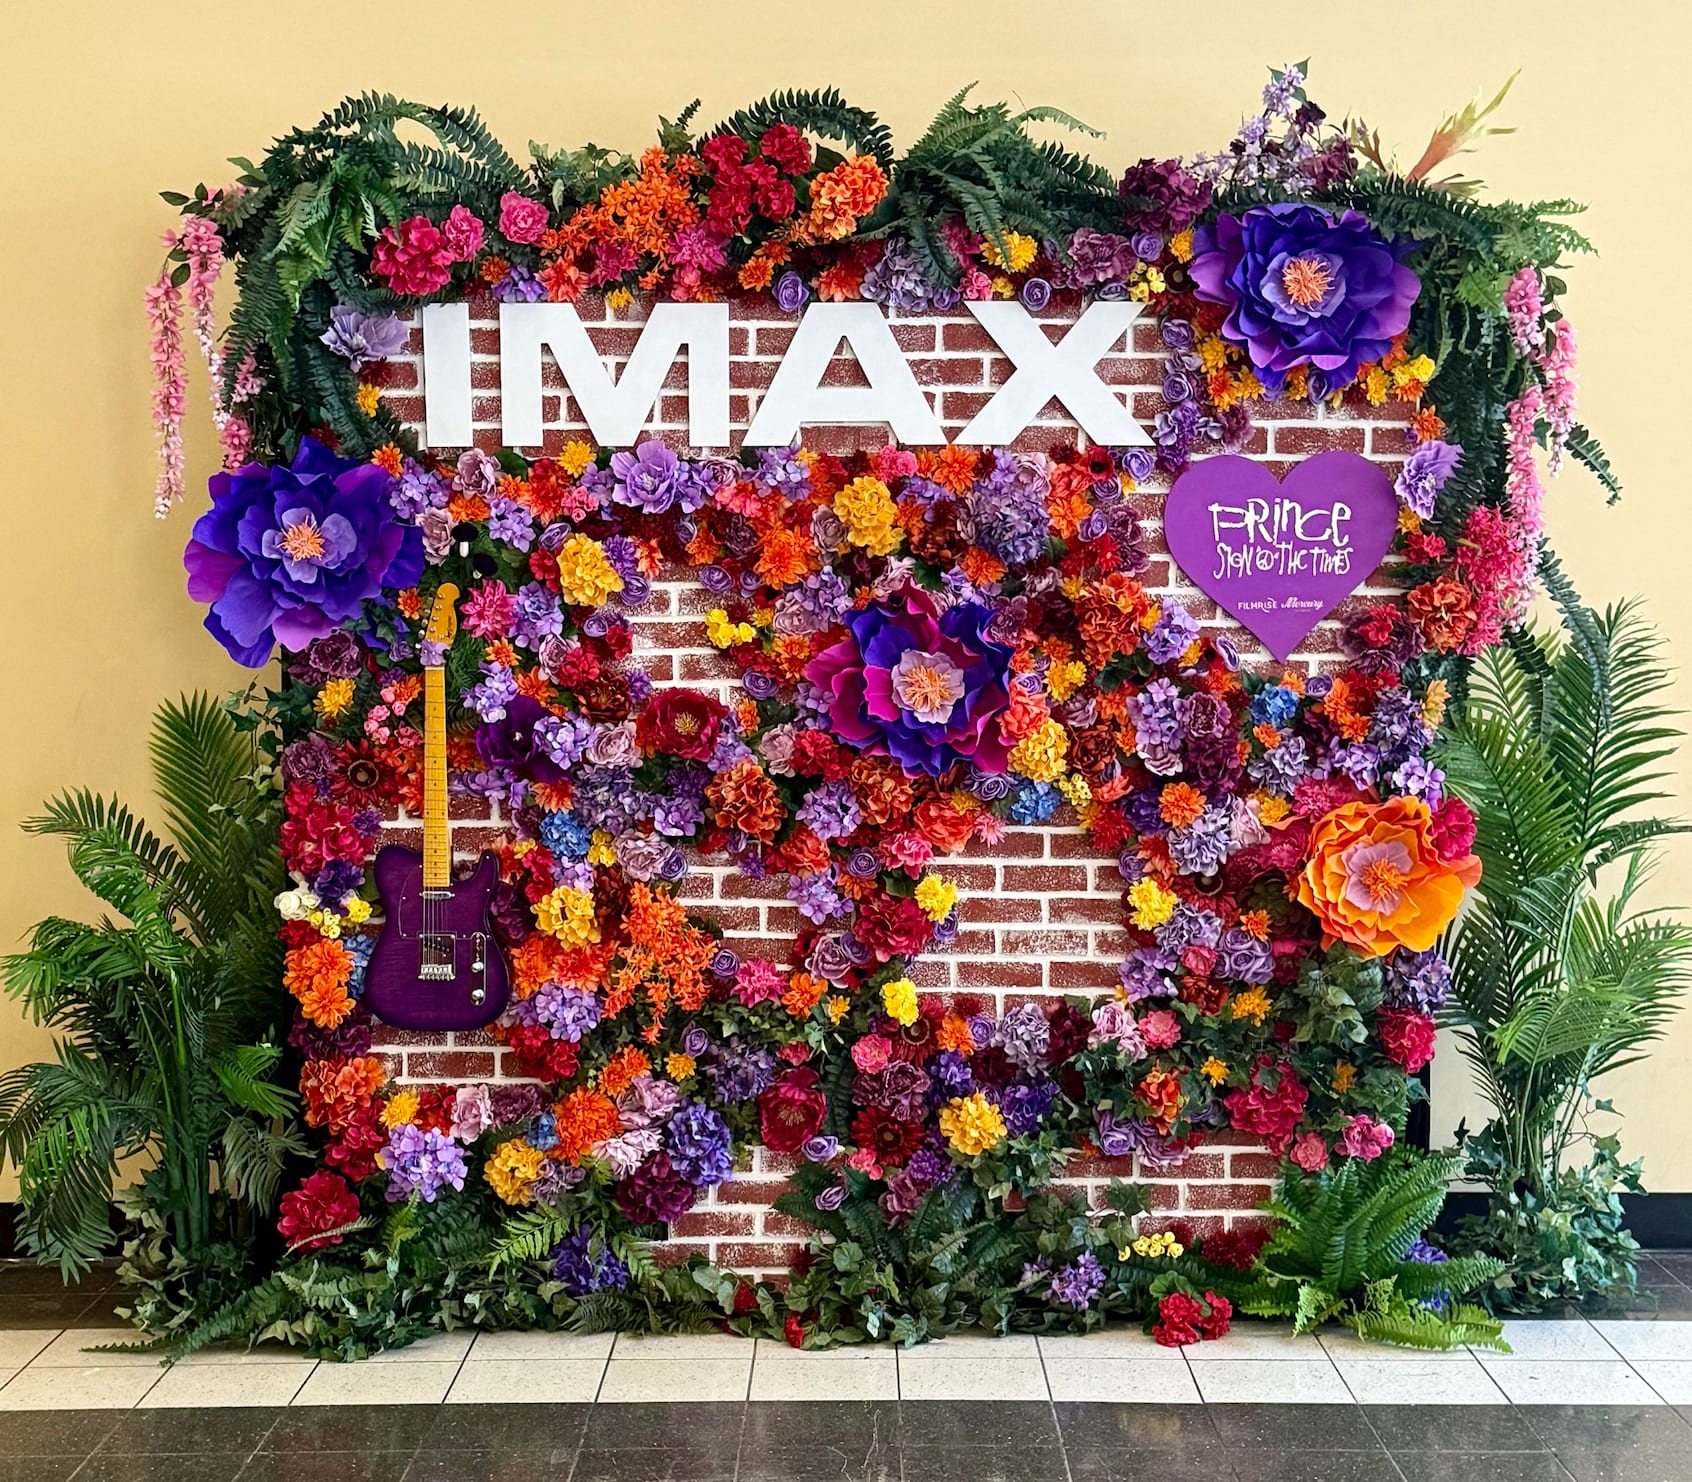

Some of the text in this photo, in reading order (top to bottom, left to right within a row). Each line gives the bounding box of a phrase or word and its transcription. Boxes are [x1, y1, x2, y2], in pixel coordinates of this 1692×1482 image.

[422, 301, 1156, 447] IMAX
[1213, 542, 1253, 579] SIGN
[1309, 546, 1354, 577] TIMES
[1280, 596, 1324, 611] Mercury
